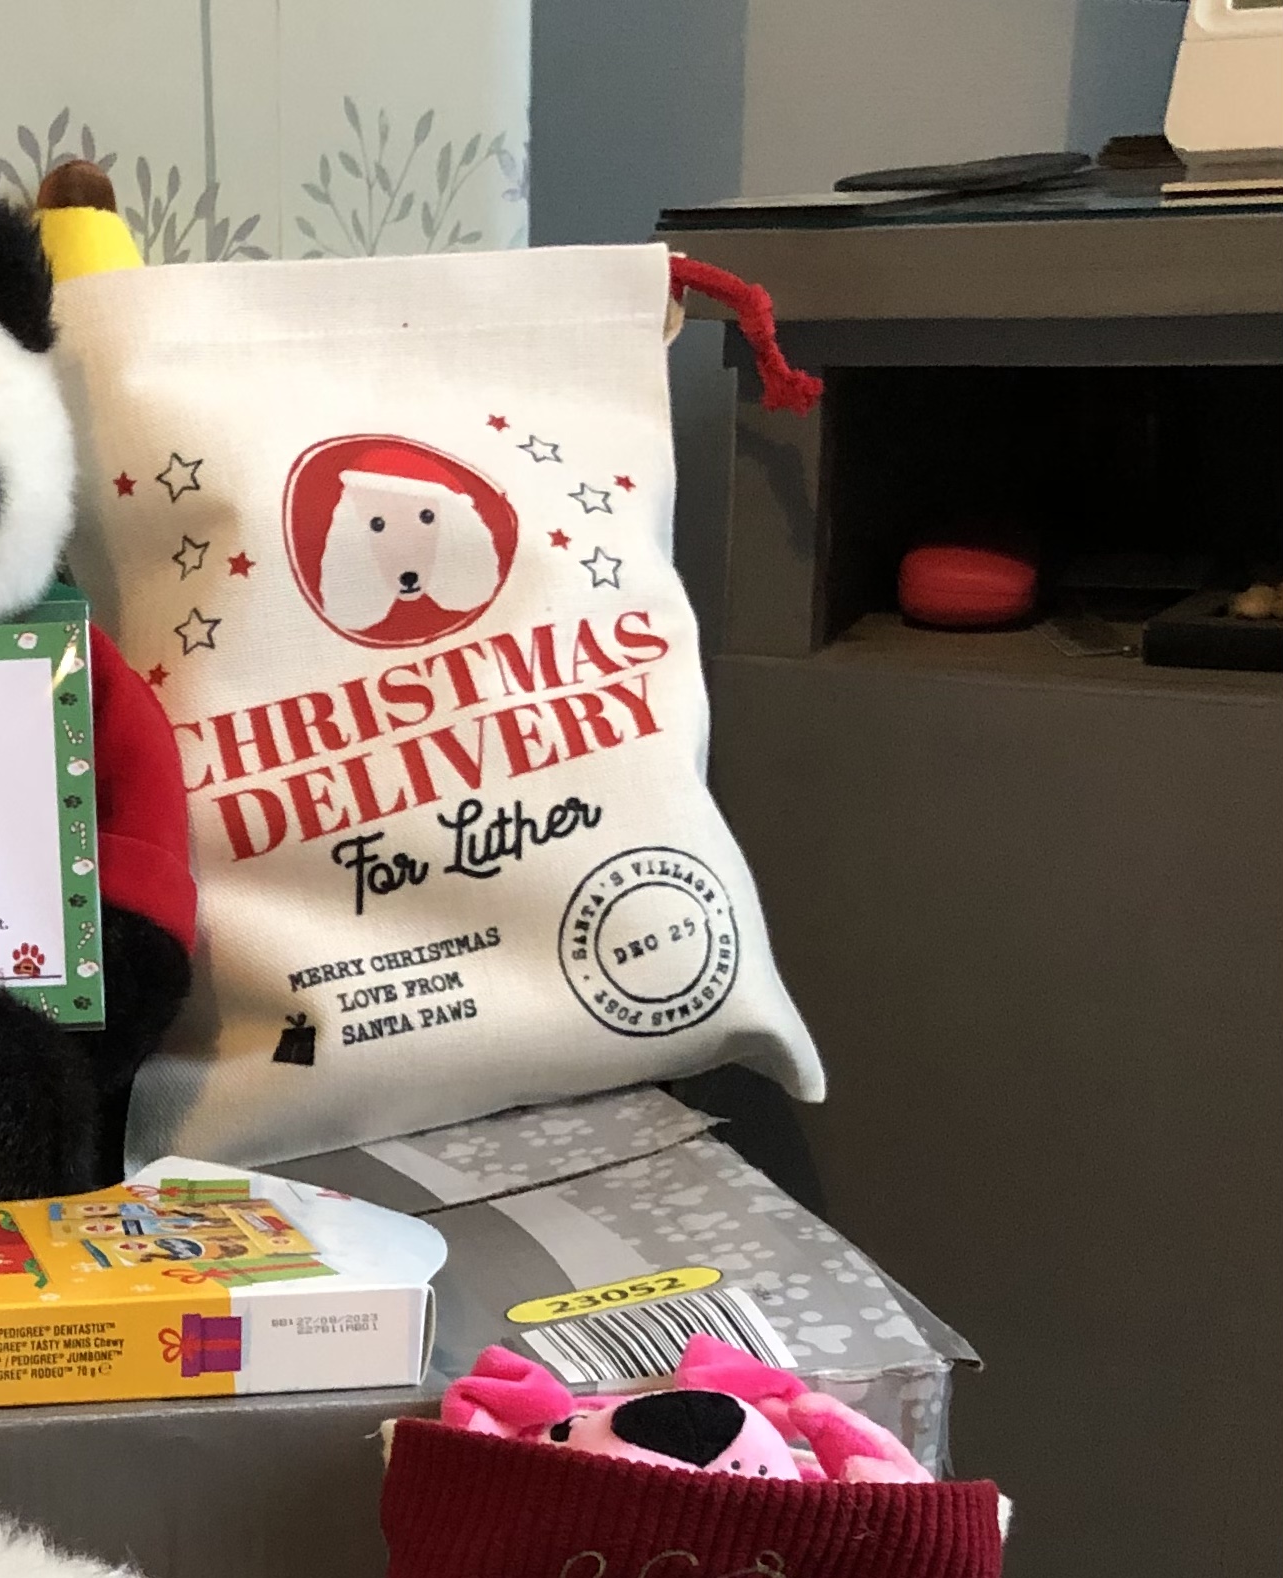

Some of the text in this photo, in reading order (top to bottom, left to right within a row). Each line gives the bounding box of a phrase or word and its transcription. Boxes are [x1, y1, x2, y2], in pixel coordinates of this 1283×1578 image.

[172, 610, 670, 794] CHRISTMAS
[212, 672, 665, 862] DELIVERY
[331, 796, 602, 916] For Luther
[631, 860, 715, 903] VILLAGE
[288, 926, 502, 992] MERRY CHRISTMAS
[613, 917, 696, 964] DEC 25
[336, 971, 464, 1013] LOVE FROM
[594, 990, 642, 1026] POST
[341, 998, 478, 1046] SANTA PAWS
[545, 1276, 687, 1315] 23052
[30, 1339, 59, 1351] TASTY
[63, 1337, 91, 1349] MINIS
